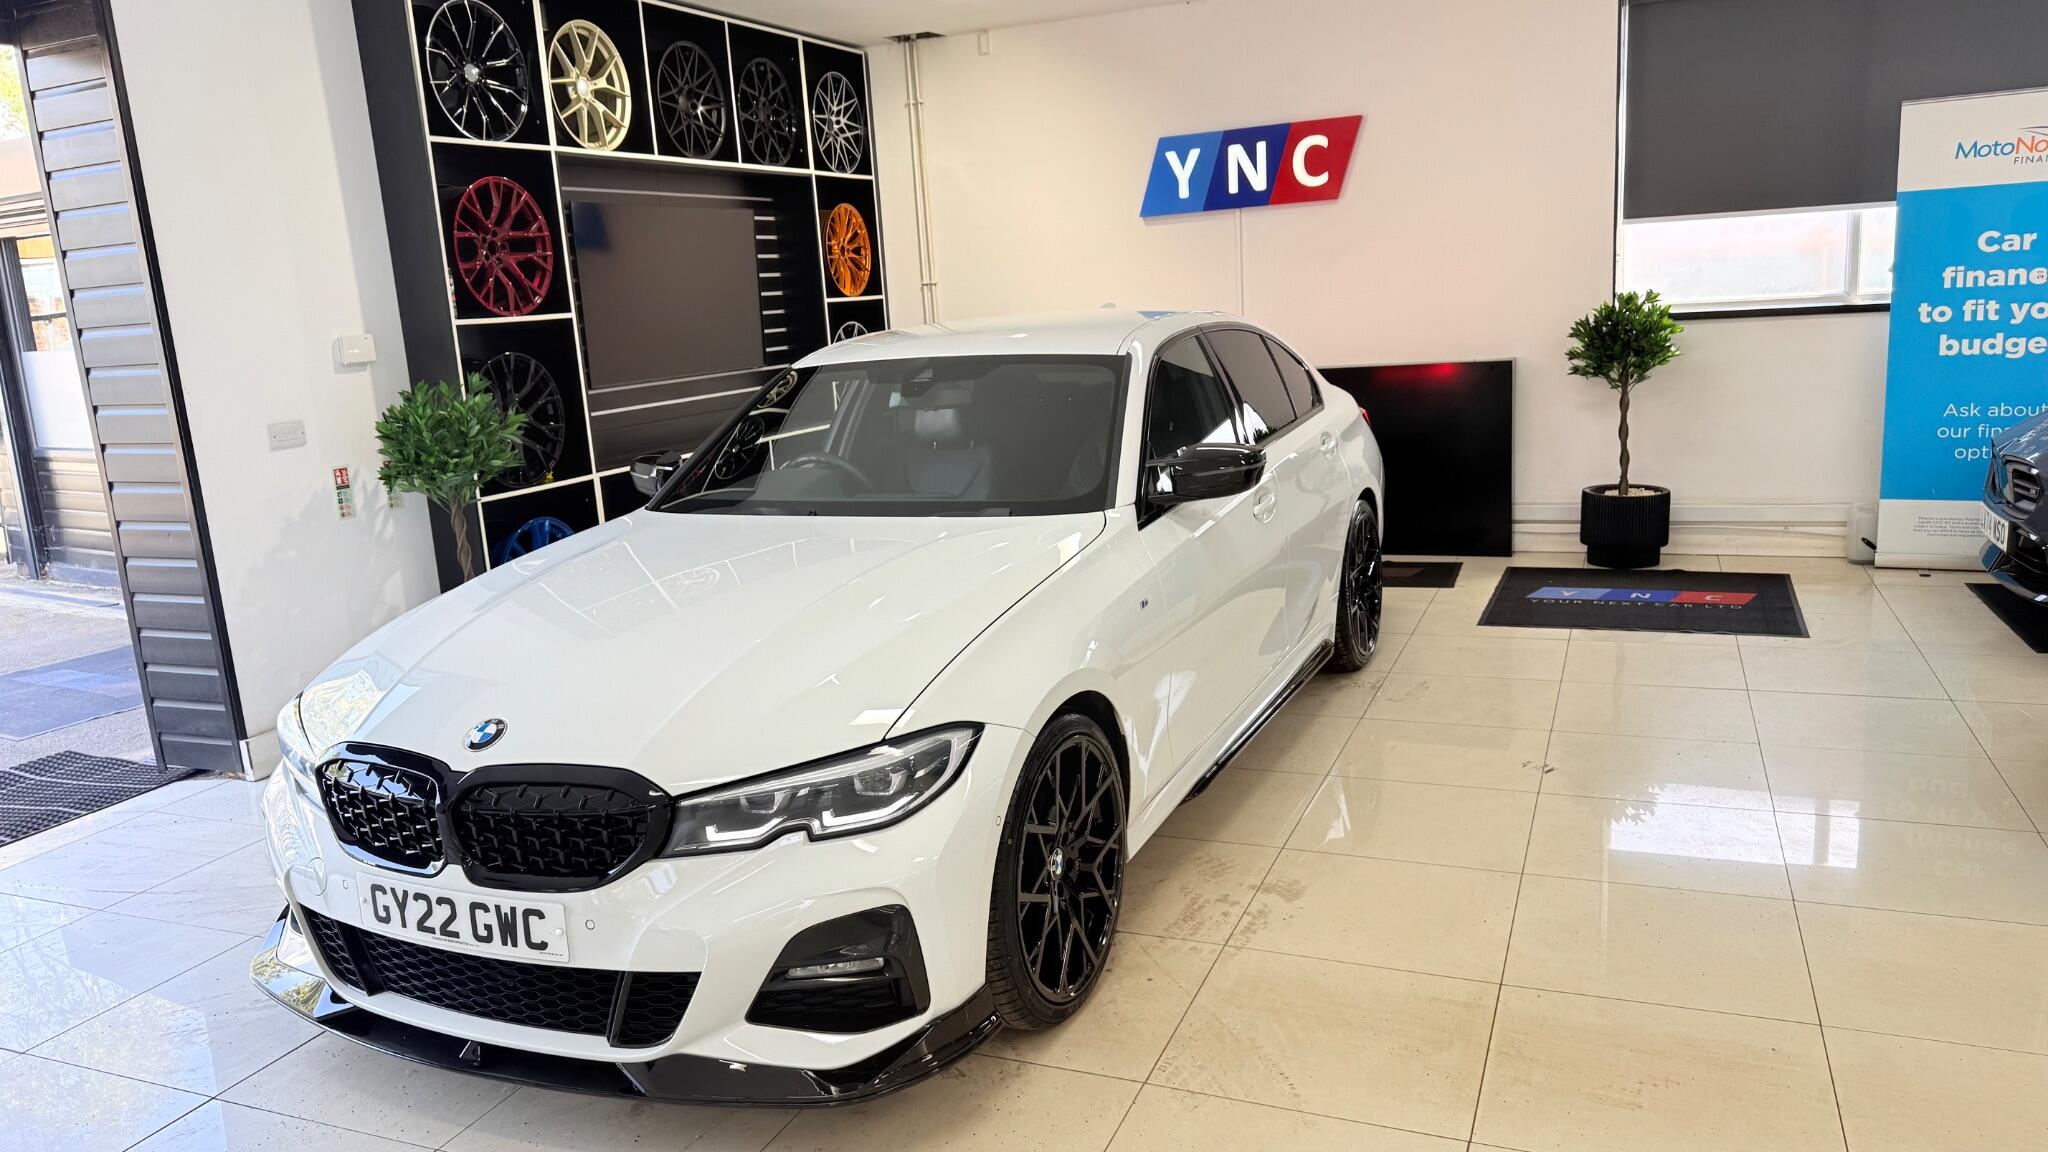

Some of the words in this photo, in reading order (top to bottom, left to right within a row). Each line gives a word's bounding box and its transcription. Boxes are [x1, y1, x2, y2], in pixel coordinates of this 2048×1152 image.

[1955, 136, 2048, 160] MotoNo
[1165, 134, 1329, 199] YNC
[1978, 230, 2038, 253] Car
[1918, 302, 1953, 324] to
[1962, 299, 2000, 322] fit
[2009, 302, 2048, 325] yo
[1939, 332, 2048, 359] budge
[1943, 402, 1981, 418] Ask
[1937, 427, 1971, 438] our
[1978, 423, 2009, 438] fin
[1954, 445, 1992, 462] opt
[370, 883, 460, 939] GY22
[469, 901, 549, 951] GWC
